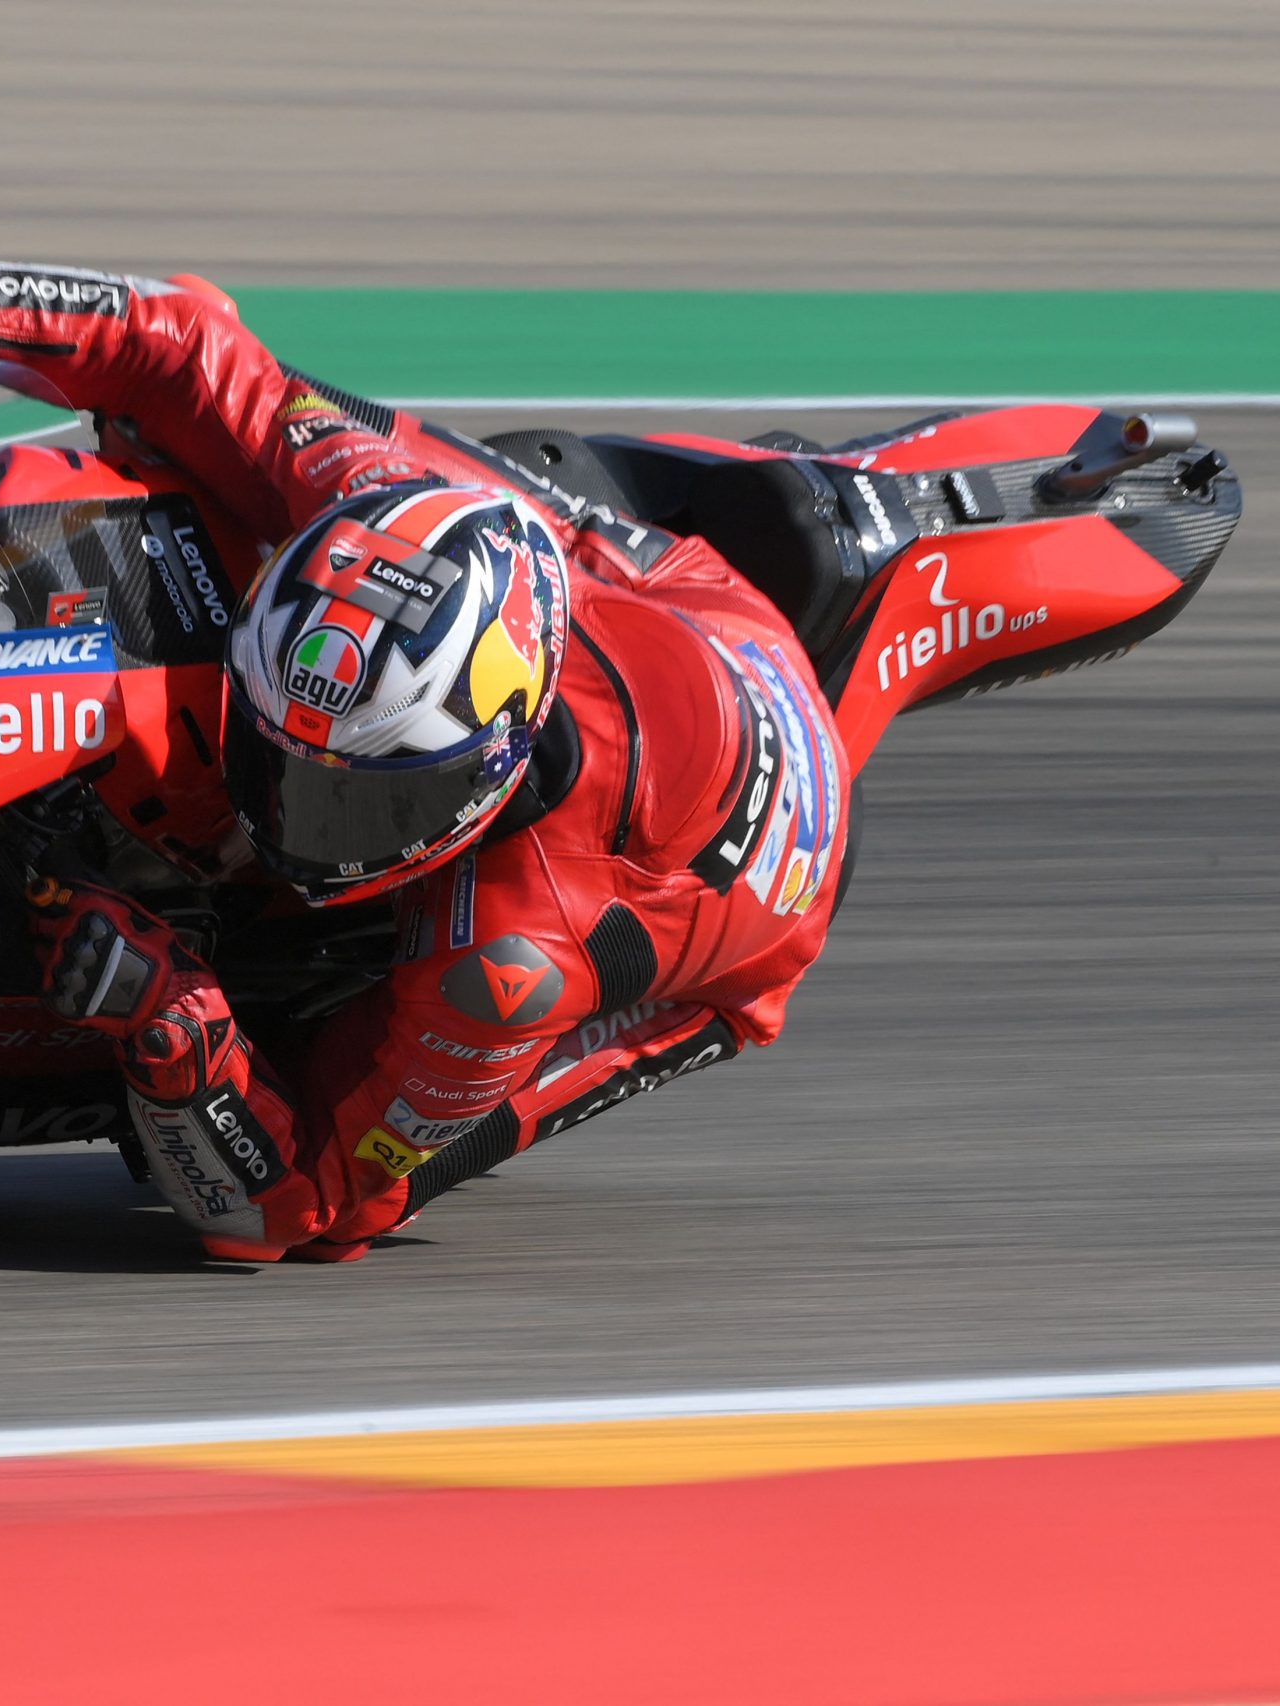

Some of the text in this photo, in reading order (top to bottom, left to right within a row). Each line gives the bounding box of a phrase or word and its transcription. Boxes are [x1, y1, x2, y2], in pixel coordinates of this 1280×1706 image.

[0, 275, 120, 316] Lenovo
[852, 473, 896, 546] DUCATI
[172, 525, 229, 627] Lenovo
[372, 560, 434, 598] Lenovo
[154, 559, 194, 633] motorola
[877, 603, 1049, 692] riello ups
[291, 666, 350, 713] agv
[455, 798, 479, 824] CAT
[401, 838, 428, 861] CAT
[338, 861, 365, 878] CAT
[419, 1031, 540, 1064] DAINESE
[425, 1084, 508, 1101] Audi Sport
[205, 1092, 268, 1181] Lenovo
[373, 1141, 408, 1170] Q1
